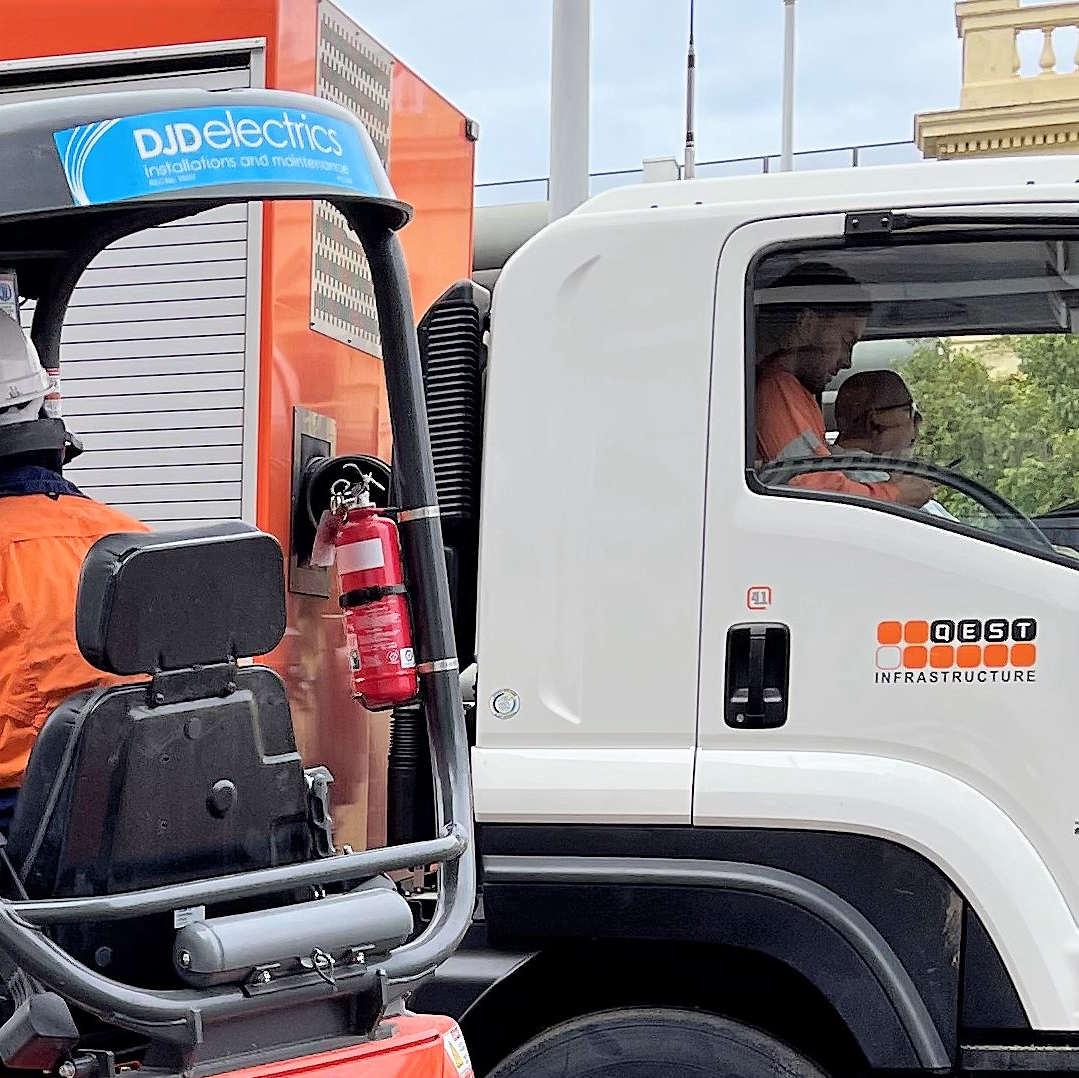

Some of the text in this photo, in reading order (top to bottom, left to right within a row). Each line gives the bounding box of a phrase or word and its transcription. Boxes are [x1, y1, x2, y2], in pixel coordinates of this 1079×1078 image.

[143, 153, 349, 178] installations and maintenance
[934, 621, 1032, 642] QEST
[875, 670, 1036, 683] INFRASTRUCTURE
